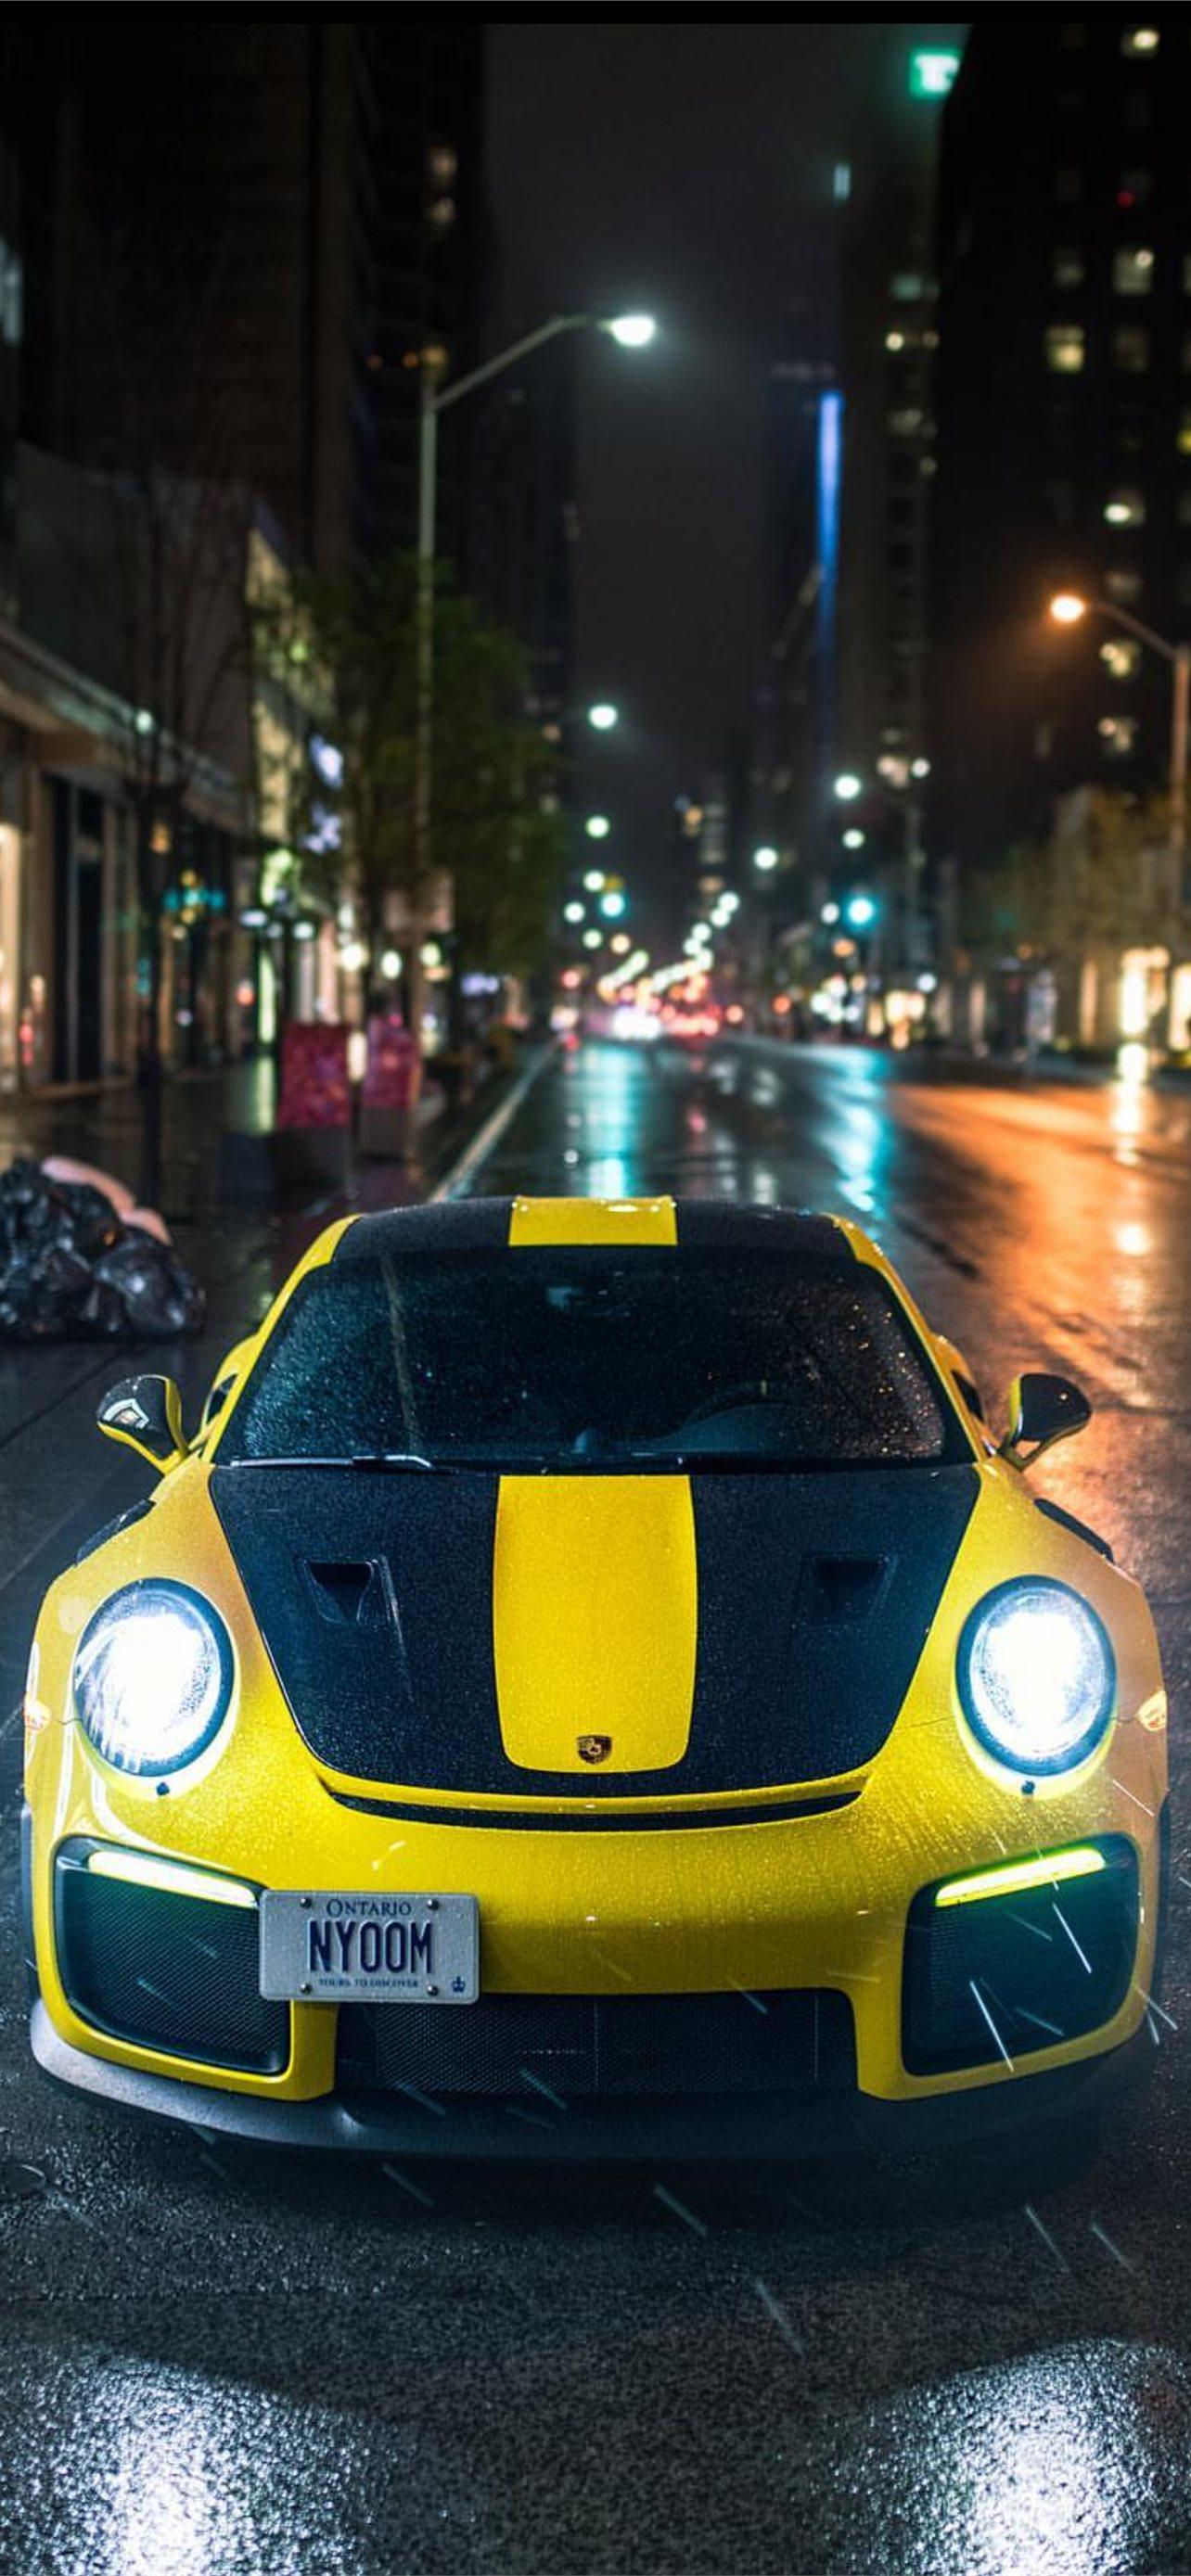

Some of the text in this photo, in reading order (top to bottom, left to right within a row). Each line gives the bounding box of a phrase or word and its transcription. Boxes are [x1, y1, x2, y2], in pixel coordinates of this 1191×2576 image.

[327, 1898, 411, 1917] ONTARIO
[309, 1920, 432, 1973] NYOOM
[355, 1978, 367, 1986] TO
[371, 1979, 418, 1987] DISCOVER
